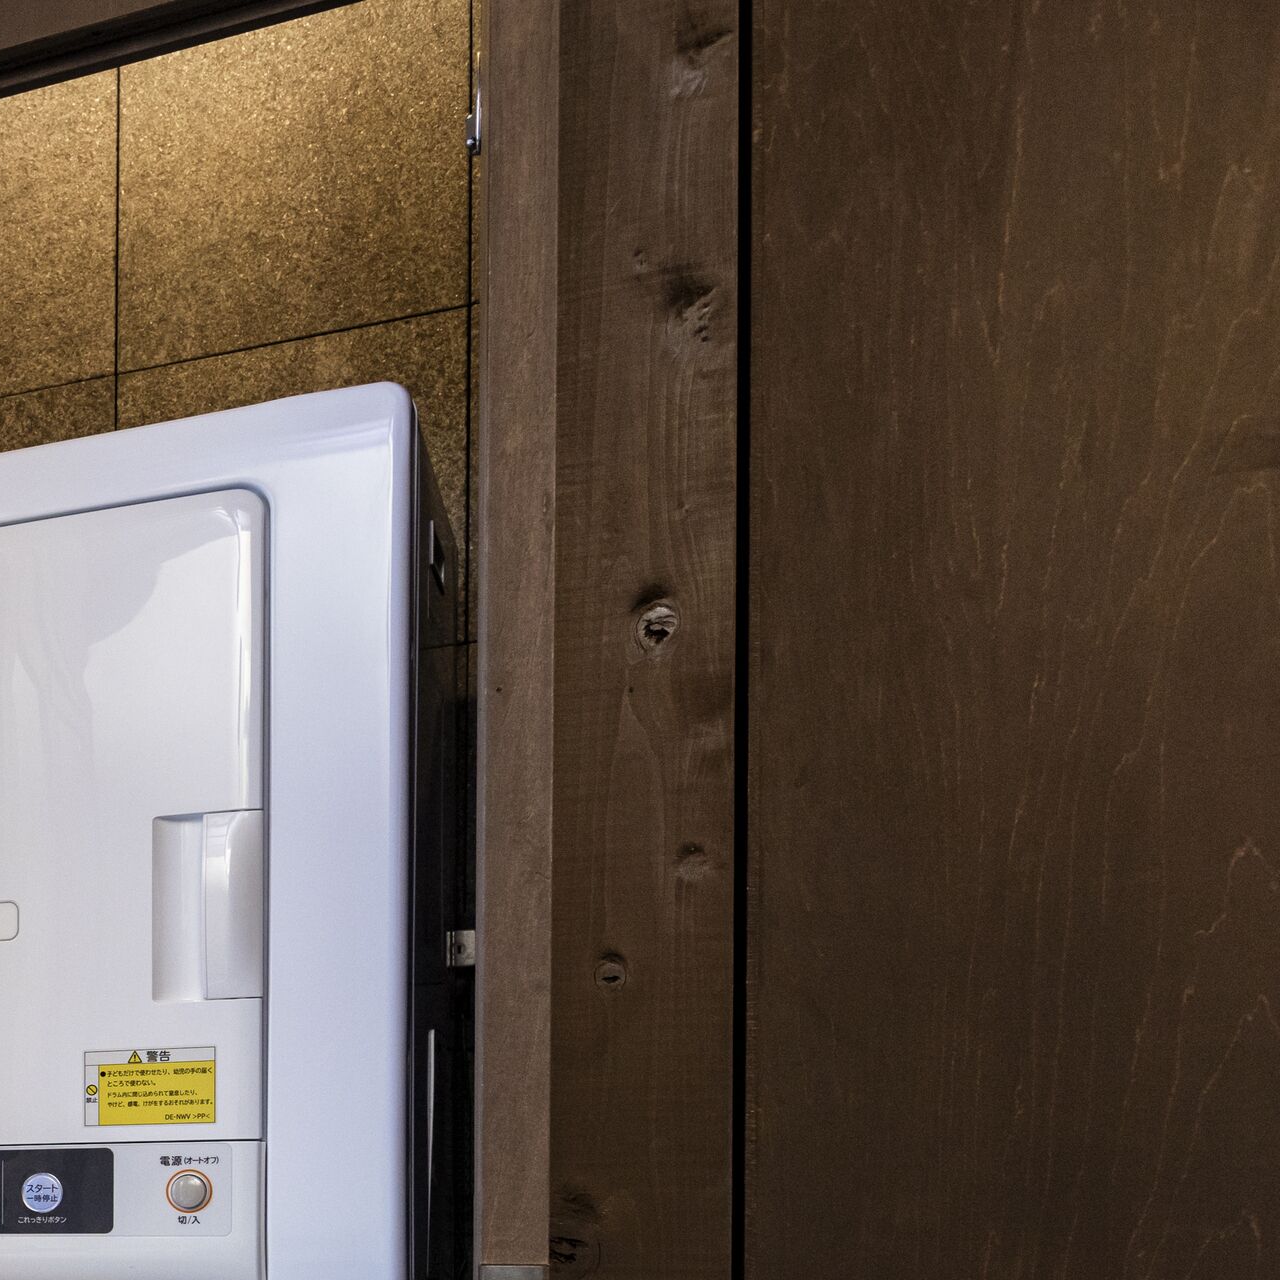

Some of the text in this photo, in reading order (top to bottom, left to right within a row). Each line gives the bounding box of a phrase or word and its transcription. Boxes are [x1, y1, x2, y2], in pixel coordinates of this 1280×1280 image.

[147, 1050, 172, 1062] 警告
[107, 1080, 157, 1088] ところで使わない。
[165, 1113, 191, 1121] DE-NWV
[159, 1155, 183, 1166] 電源
[26, 1183, 59, 1193] スタート
[26, 1194, 59, 1203] 一時停止
[17, 1215, 67, 1224] これっきりボタン
[177, 1215, 201, 1225] 切/入
